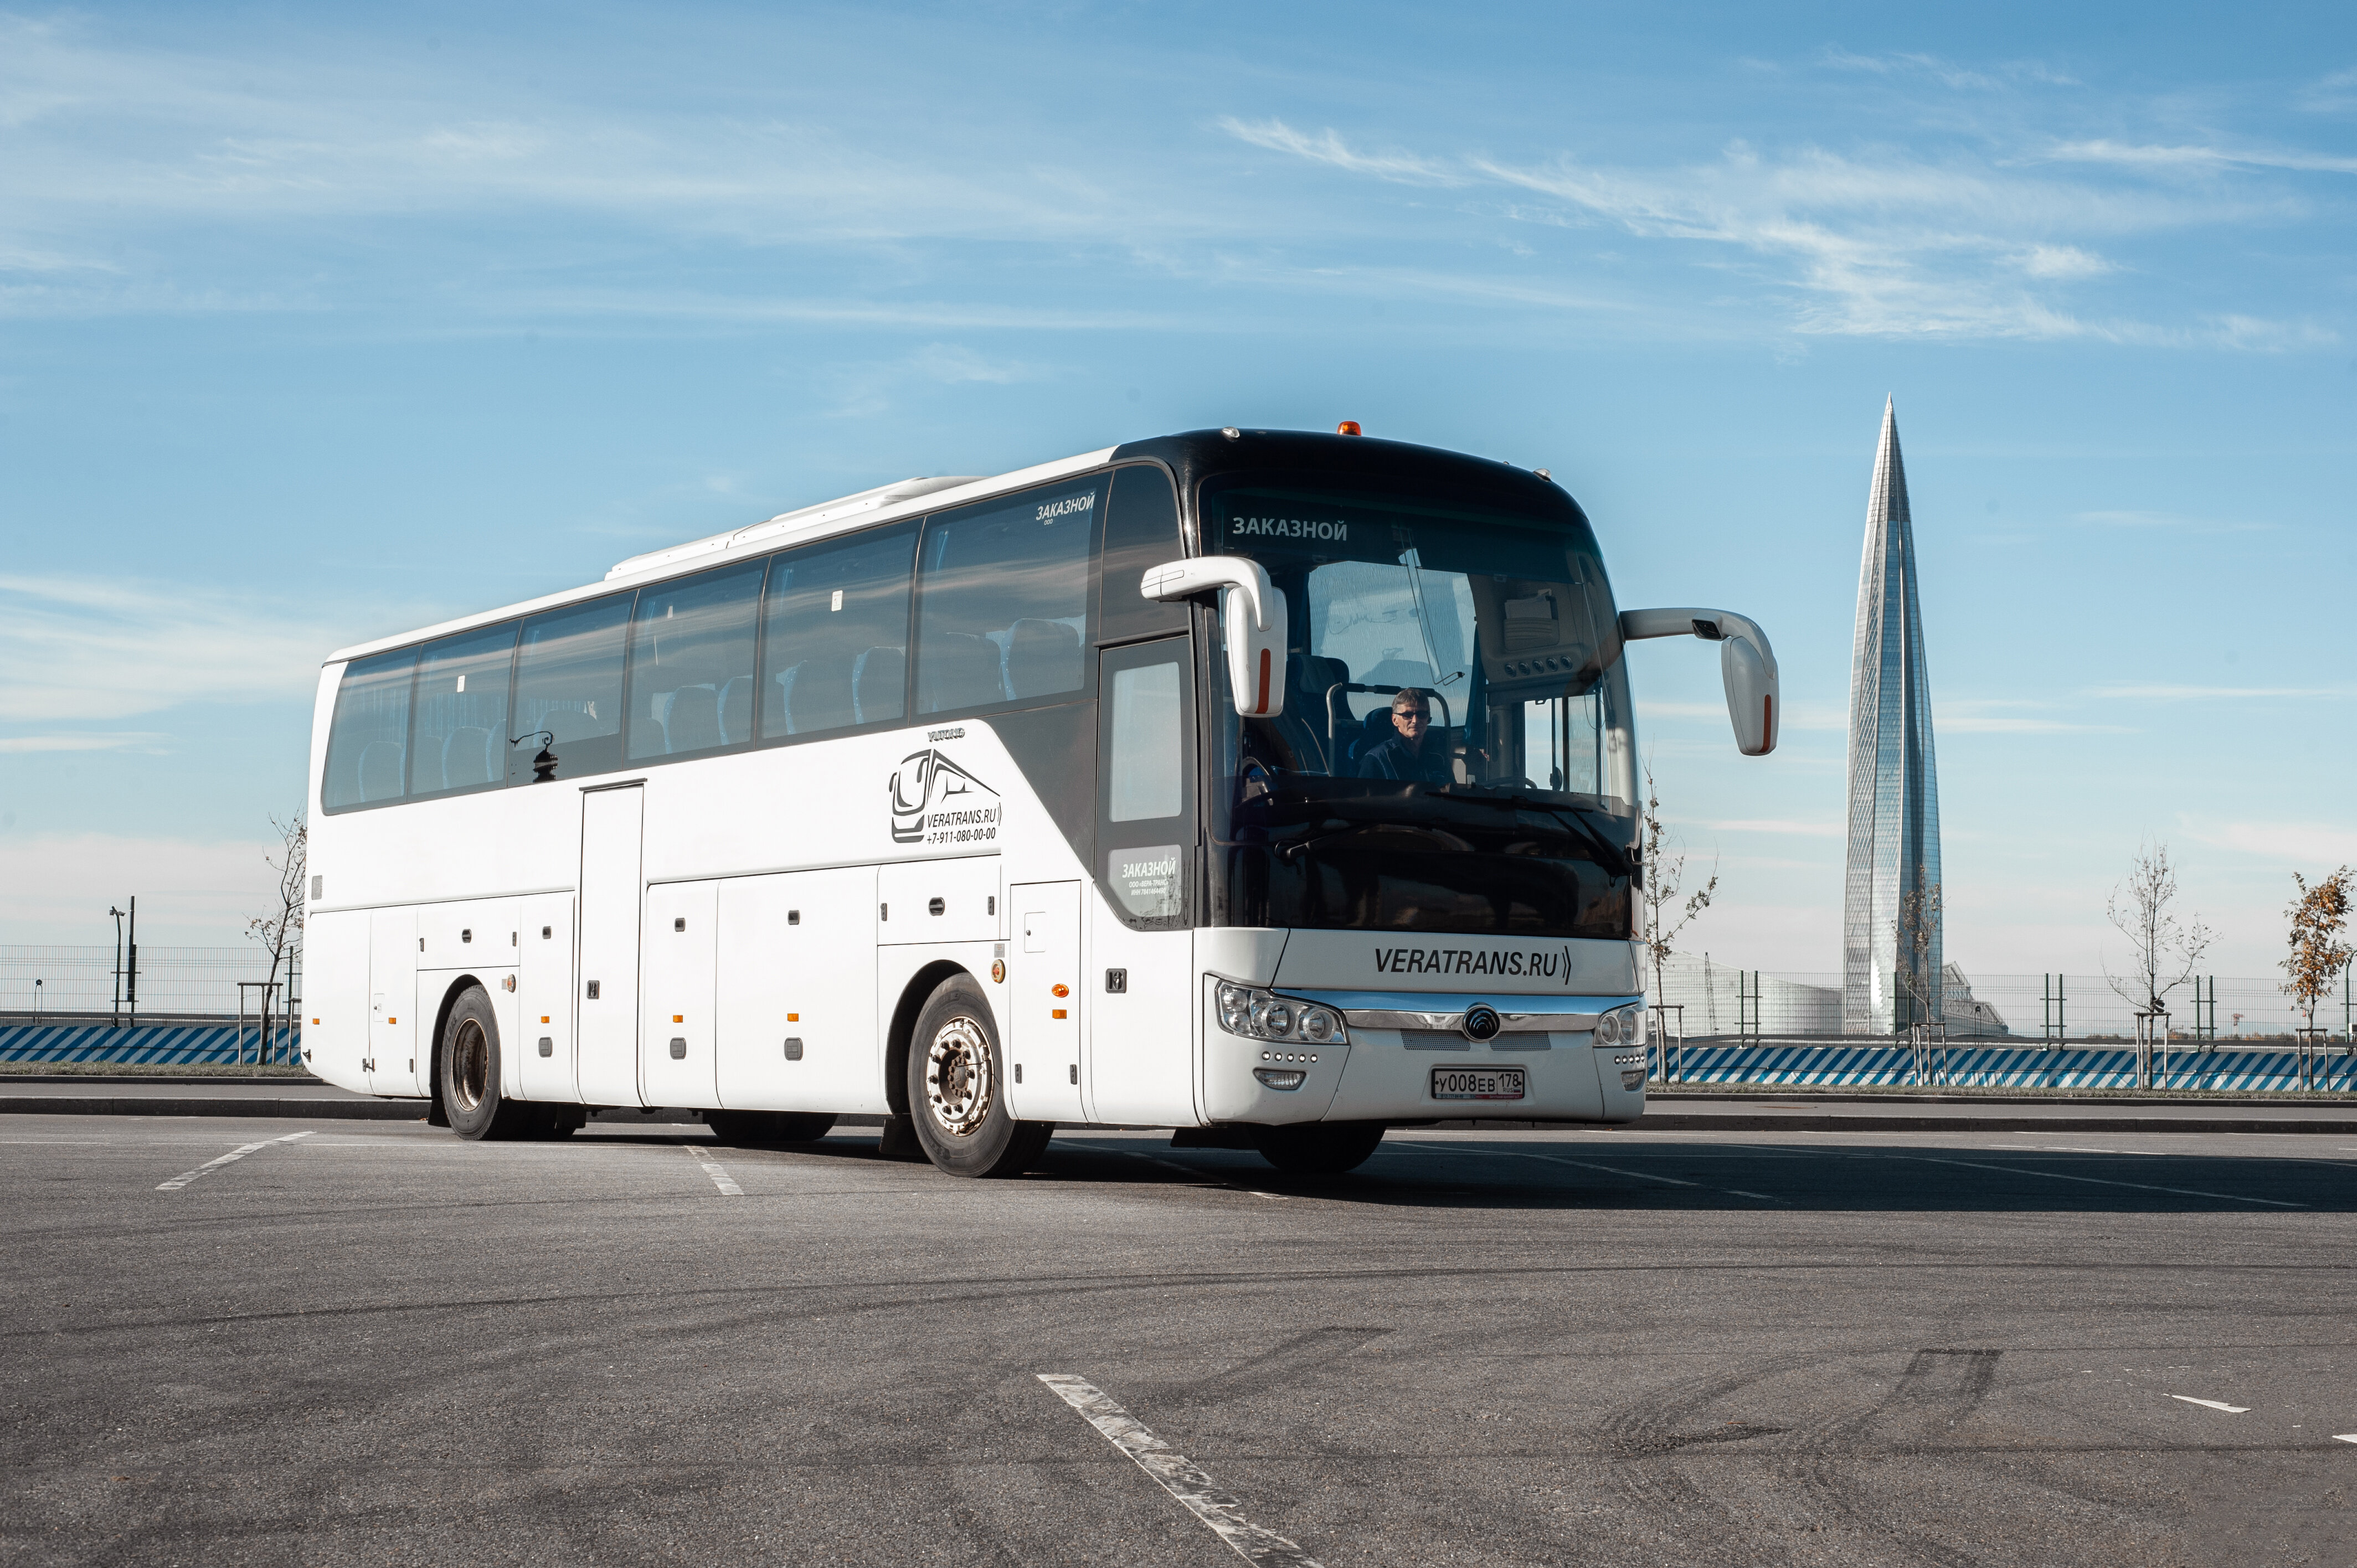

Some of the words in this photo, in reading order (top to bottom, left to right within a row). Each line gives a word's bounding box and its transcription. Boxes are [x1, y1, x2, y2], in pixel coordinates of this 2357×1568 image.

[1036, 491, 1095, 520] ЗАКАЗНОЙ
[1233, 517, 1347, 541] ЗАКАЗНОЙ
[928, 728, 965, 742] YUTONG
[928, 808, 996, 828] VERATRANS.RU
[927, 827, 996, 844] +7-911-080-00-00
[1122, 857, 1176, 878] ЗАКАЗНОЙ
[1375, 948, 1557, 977] VERATRANS.RU
[1499, 1073, 1519, 1087] 178
